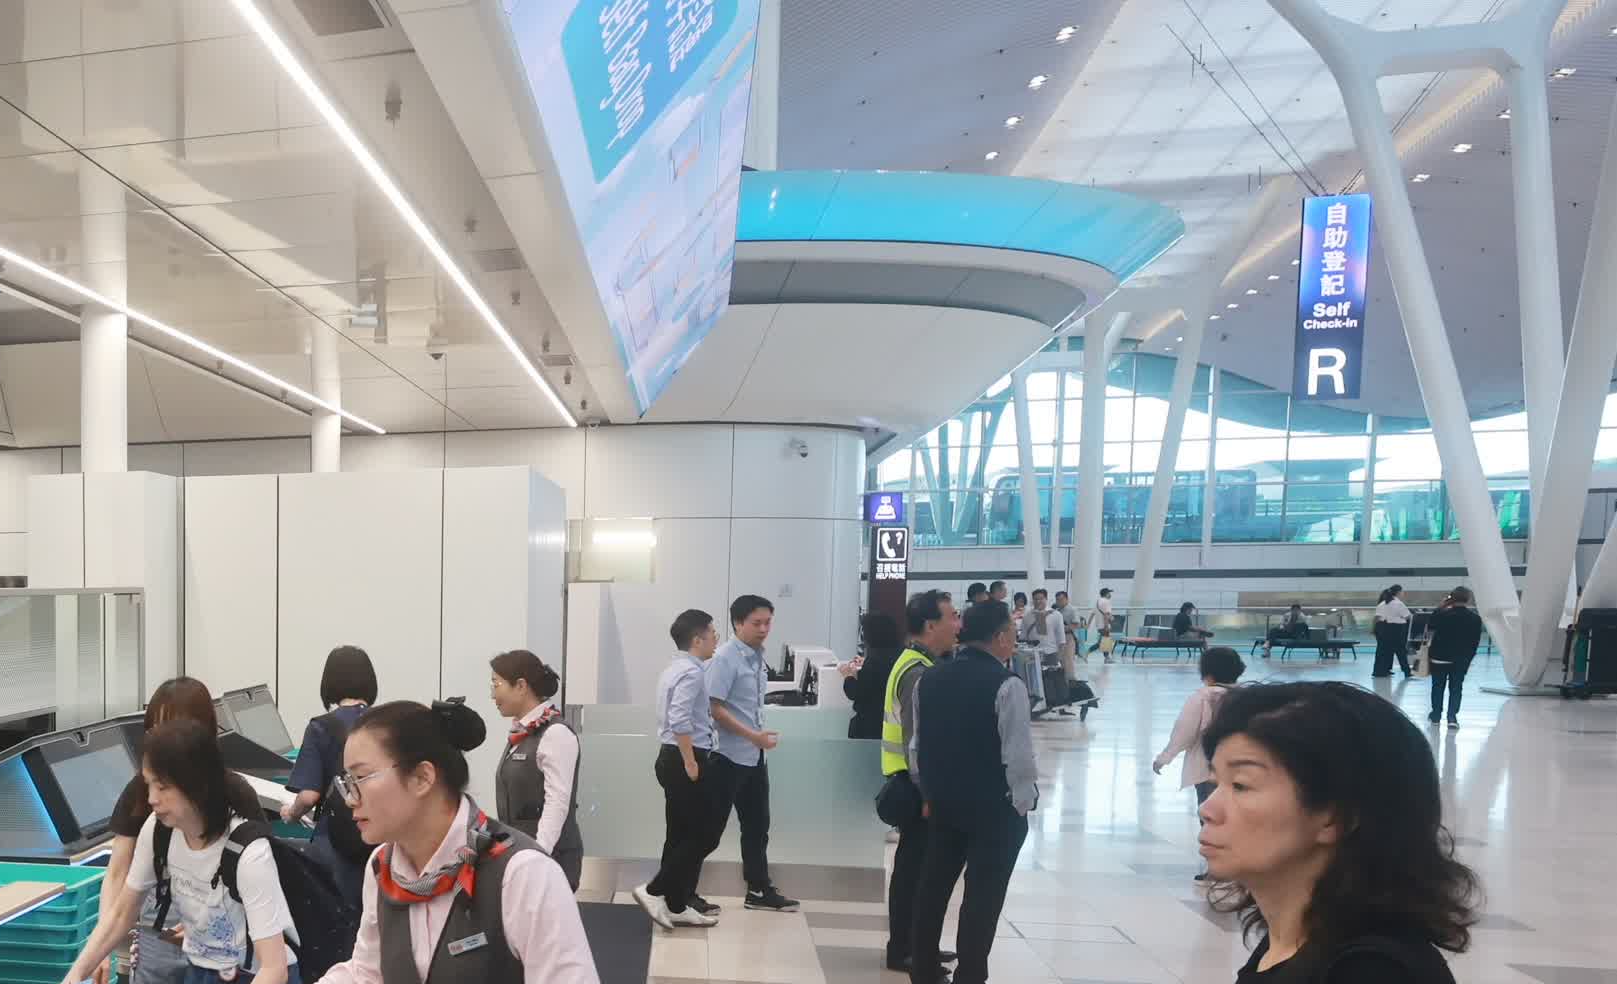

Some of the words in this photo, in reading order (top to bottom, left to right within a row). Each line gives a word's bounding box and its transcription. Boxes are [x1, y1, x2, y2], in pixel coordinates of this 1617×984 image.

[1320, 202, 1348, 297] 自助登記
[1303, 317, 1358, 330] Check-in
[1313, 301, 1351, 318] Self
[1307, 347, 1347, 396] R
